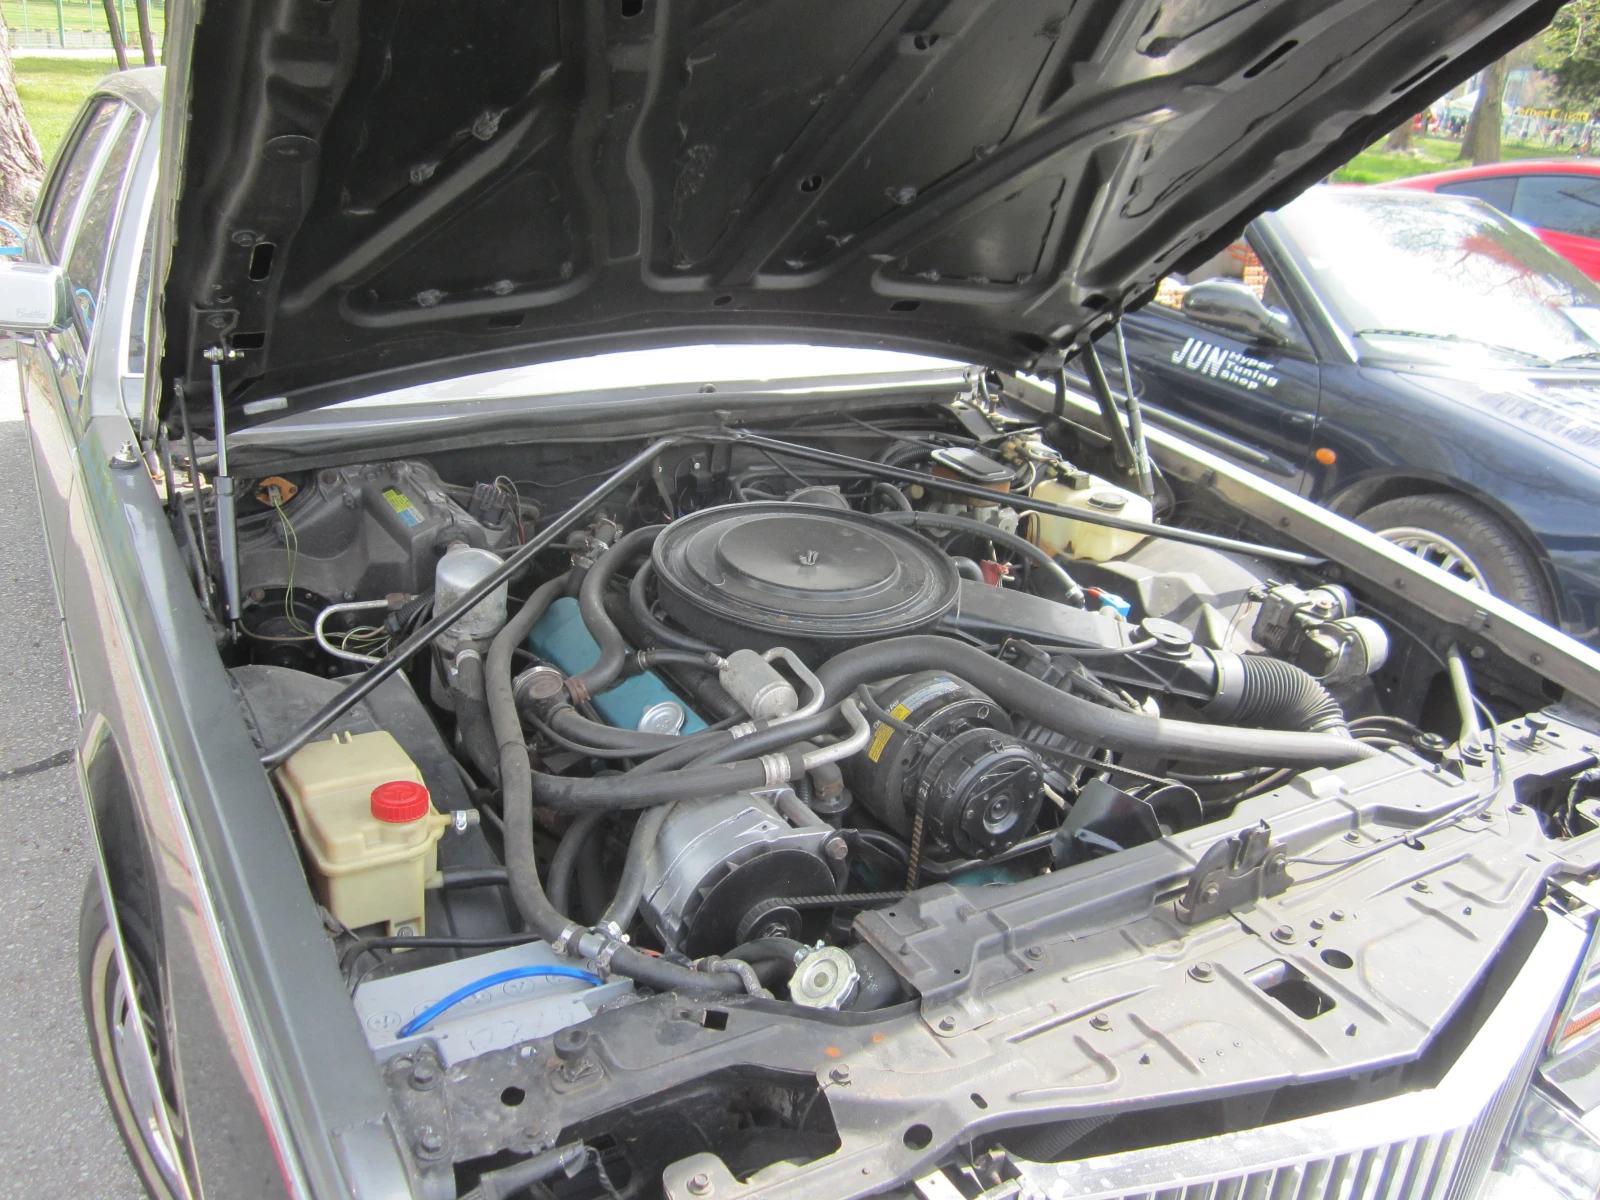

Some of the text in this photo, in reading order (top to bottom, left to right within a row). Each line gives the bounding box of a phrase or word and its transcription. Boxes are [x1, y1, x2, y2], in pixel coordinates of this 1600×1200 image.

[1171, 337, 1229, 378] JUN
[1229, 350, 1274, 371] Hyper
[1220, 369, 1258, 390] Shop
[1226, 359, 1279, 387] Tuning
